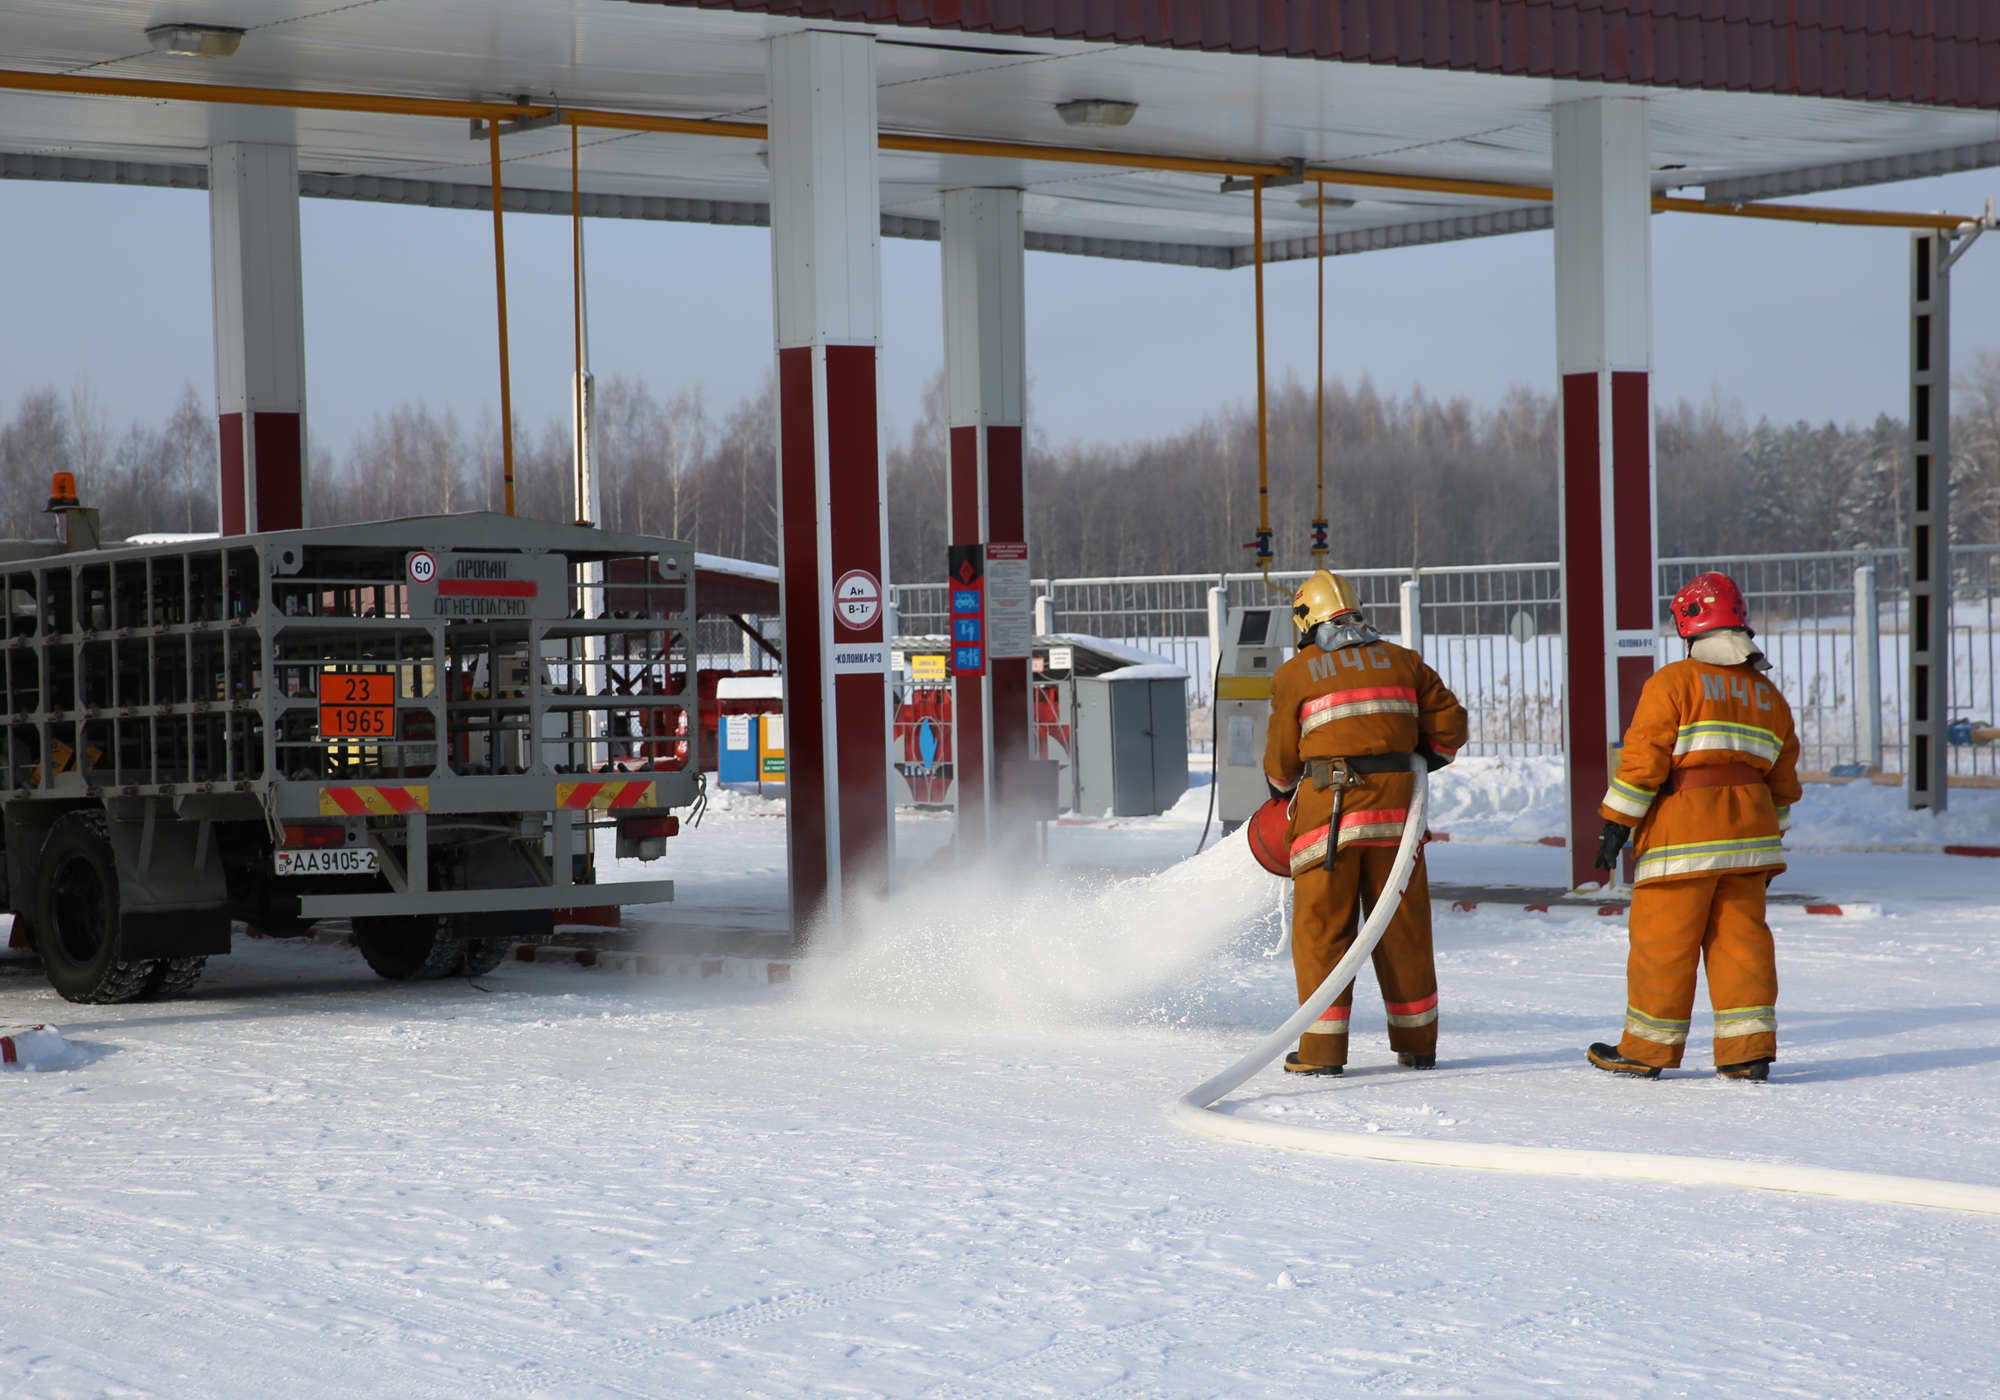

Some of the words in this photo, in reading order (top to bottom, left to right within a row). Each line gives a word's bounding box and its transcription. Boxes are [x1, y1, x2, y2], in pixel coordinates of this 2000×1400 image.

[414, 561, 431, 575] 60
[456, 559, 507, 578] ПРОПАН
[433, 597, 526, 616] ОГНЕОПАСНО
[1307, 647, 1391, 683] МЧС
[345, 678, 370, 701] 23
[1701, 673, 1772, 711] МЧС
[336, 710, 384, 733] 1965
